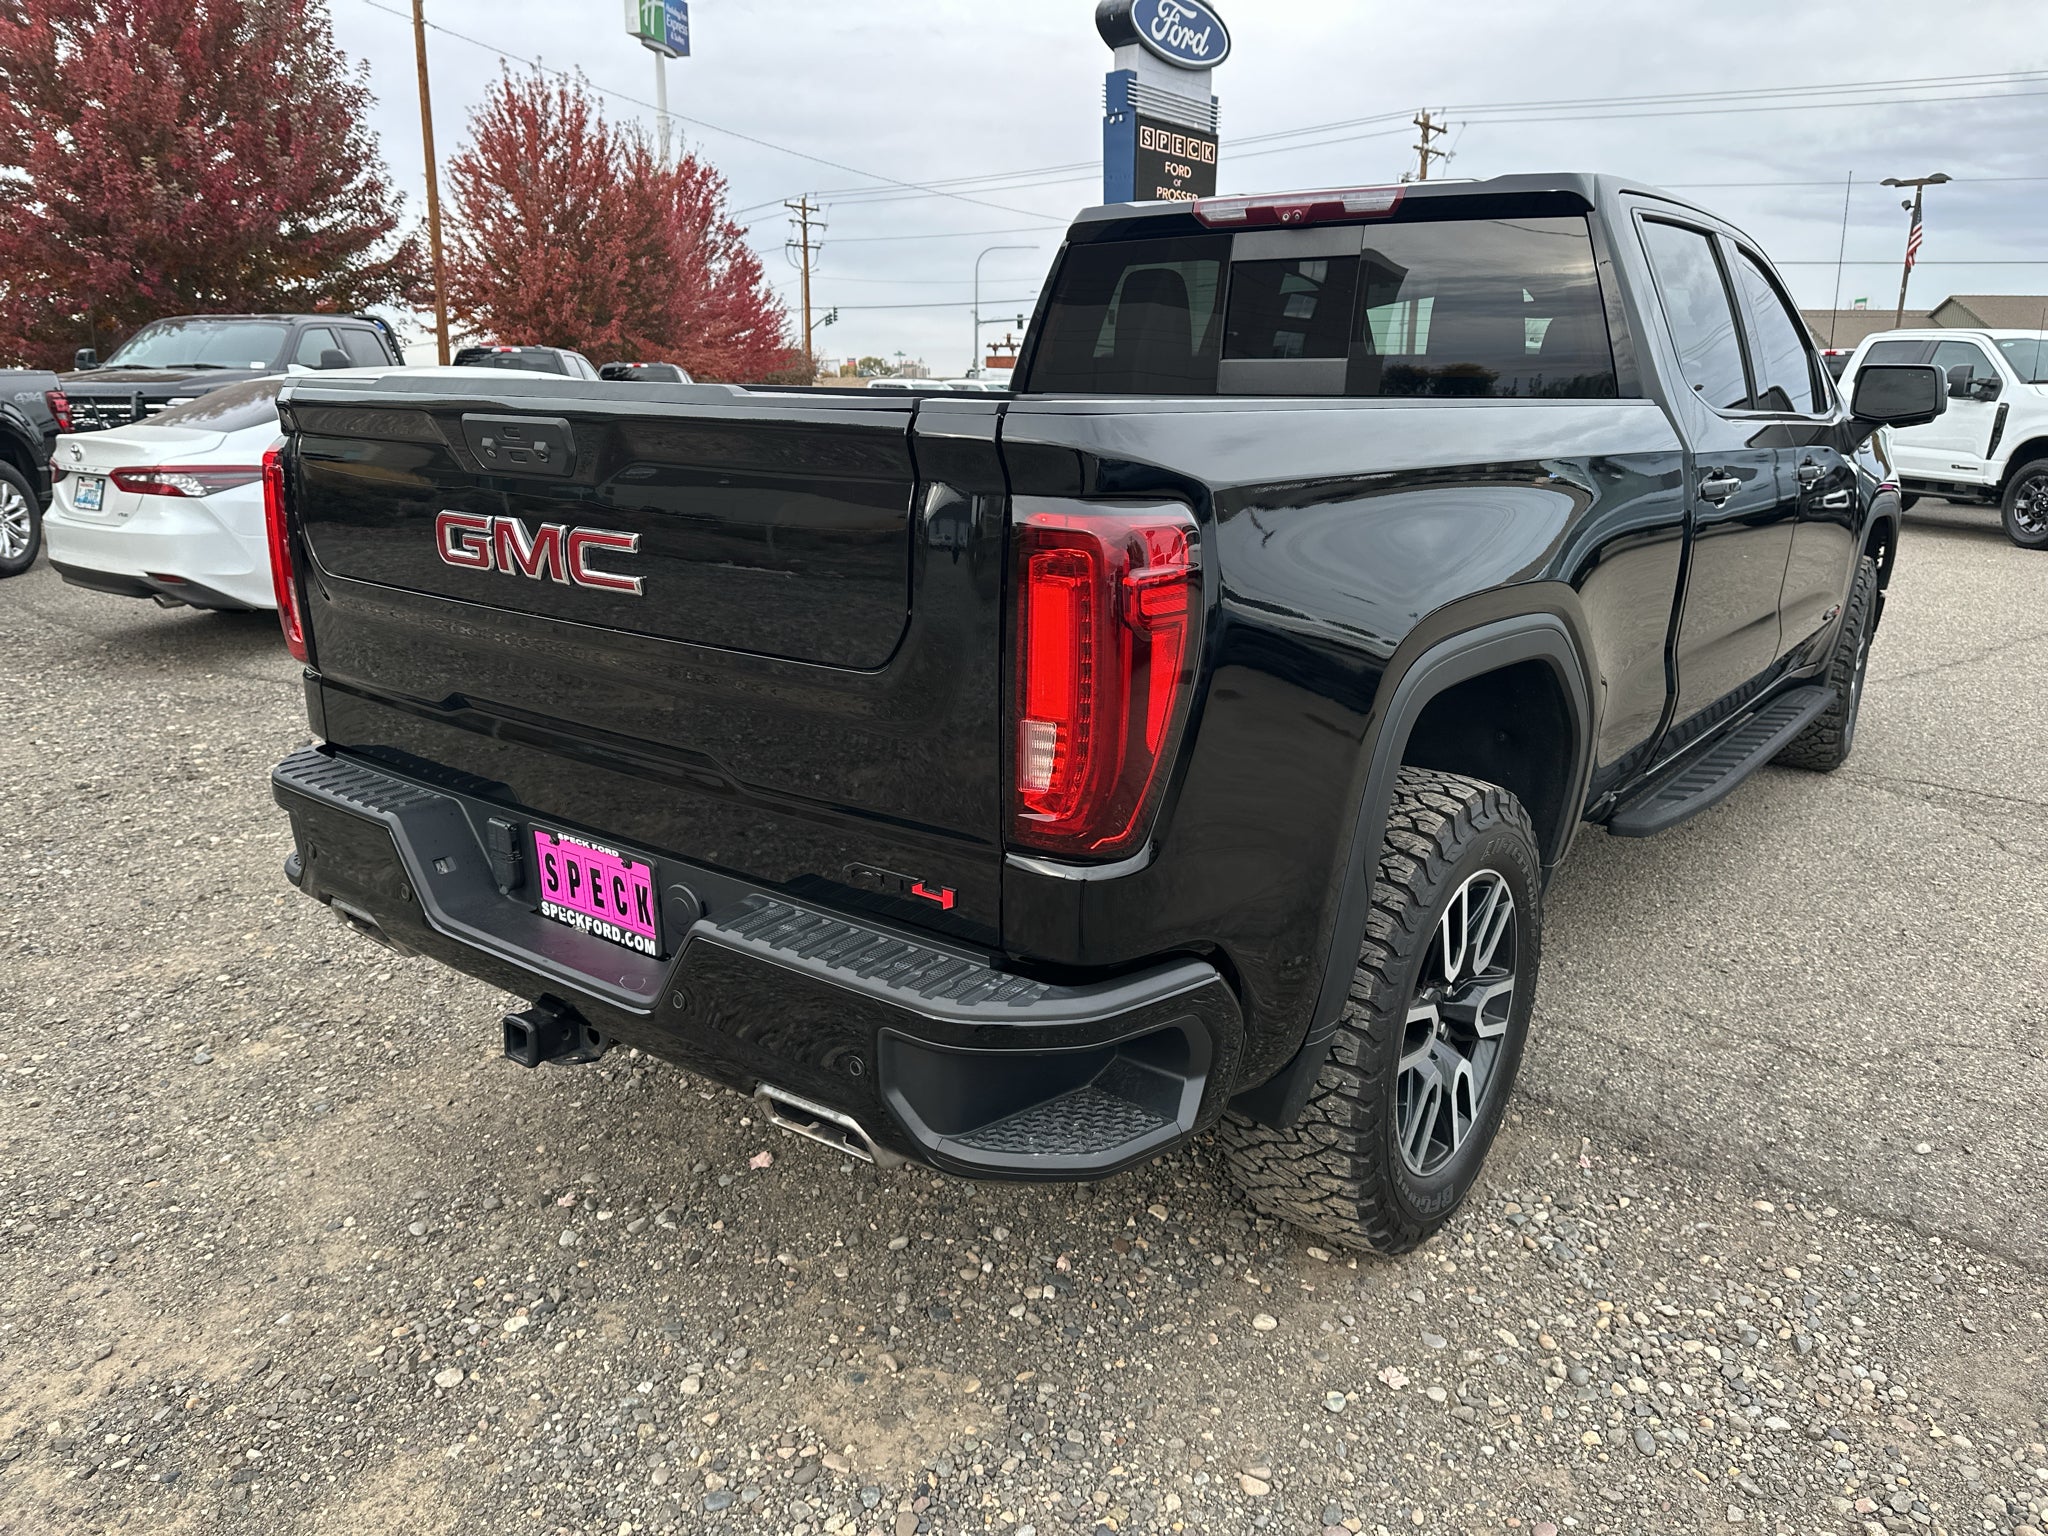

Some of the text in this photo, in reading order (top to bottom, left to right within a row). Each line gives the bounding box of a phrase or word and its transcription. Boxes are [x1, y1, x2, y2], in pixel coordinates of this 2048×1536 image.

[1151, 0, 1211, 56] Ford
[1142, 127, 1214, 162] SPECK
[1164, 161, 1192, 178] FORD
[435, 510, 646, 596] GMC
[557, 833, 619, 858] SPECK FORD
[544, 852, 653, 928] SPECK
[541, 901, 656, 956] SPECKFORD.COM
